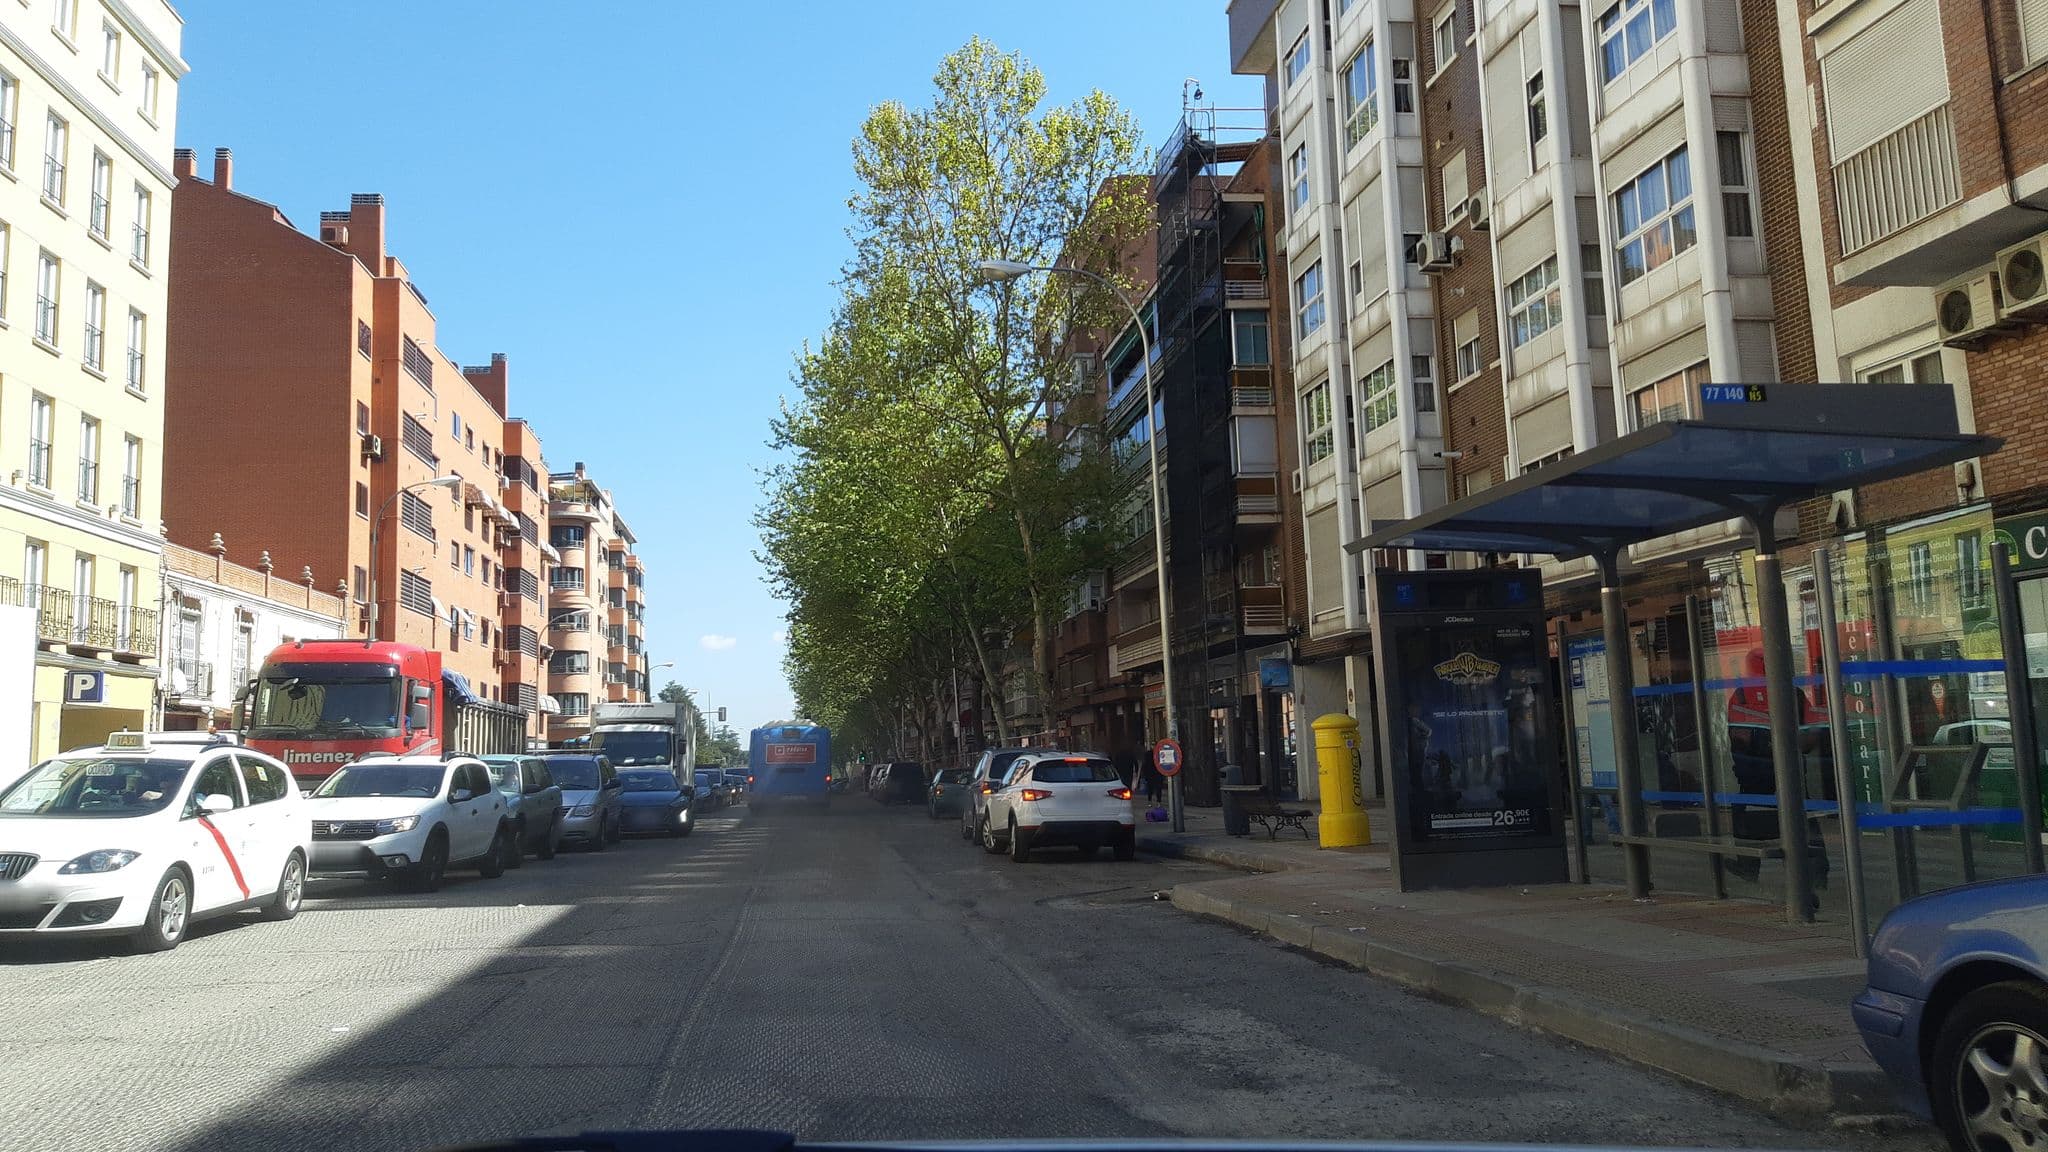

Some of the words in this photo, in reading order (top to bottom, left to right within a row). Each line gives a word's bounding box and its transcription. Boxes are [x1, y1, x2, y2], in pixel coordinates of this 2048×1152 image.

[1706, 387, 1720, 400] 77
[1724, 387, 1744, 400] 140
[72, 674, 96, 700] P
[1845, 615, 1876, 817] Herbolari
[117, 735, 137, 746] TAXI
[281, 748, 355, 763] Jimenez
